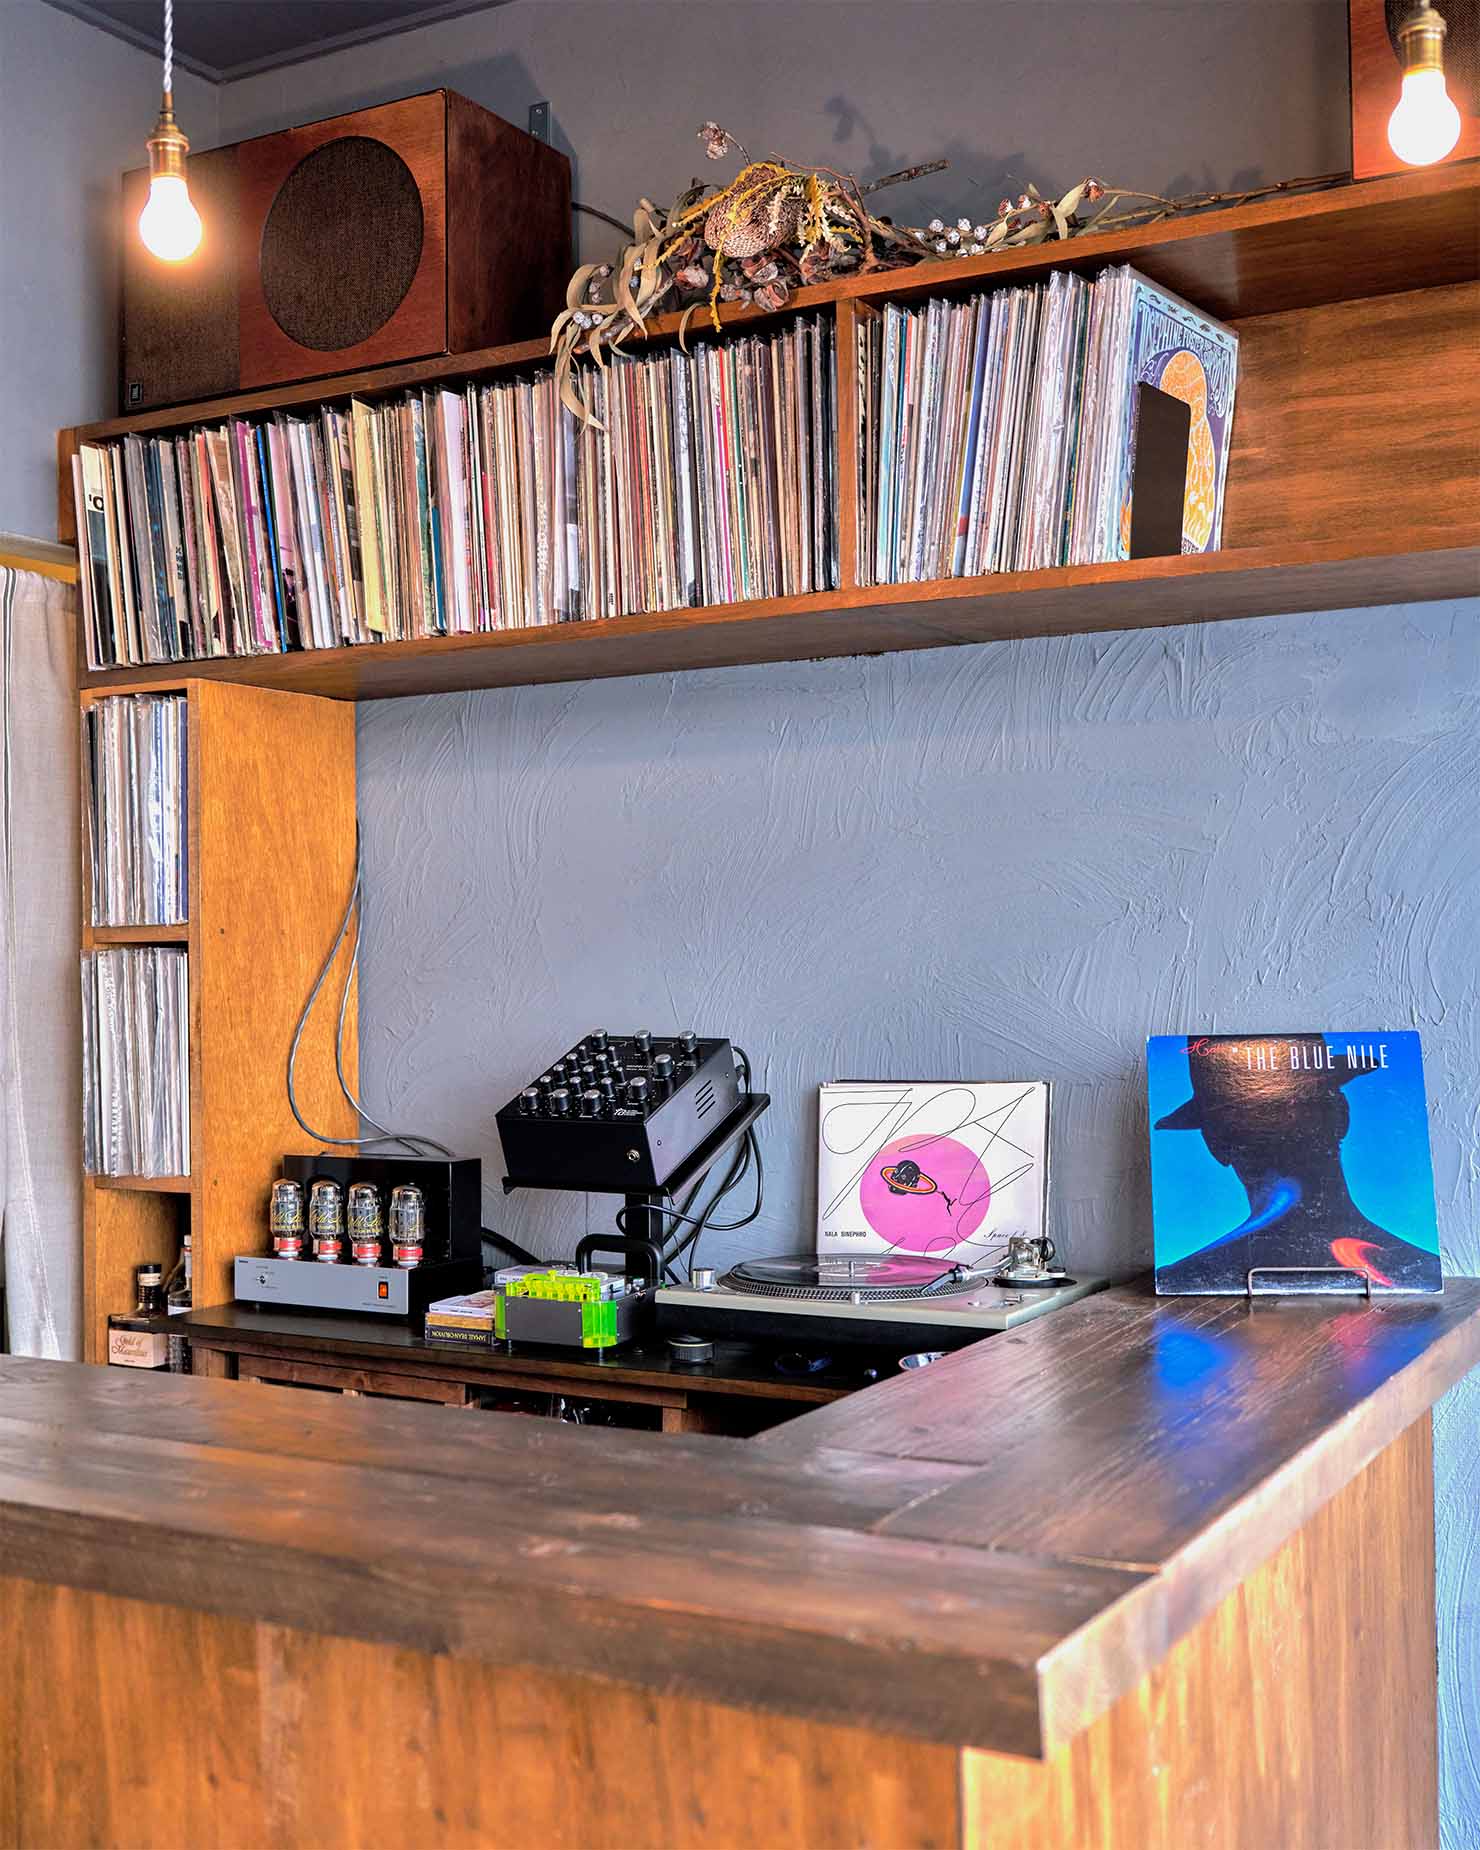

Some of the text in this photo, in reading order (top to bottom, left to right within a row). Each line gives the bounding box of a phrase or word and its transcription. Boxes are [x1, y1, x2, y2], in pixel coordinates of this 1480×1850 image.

[1246, 1044, 1390, 1070] THE BLUE NILE
